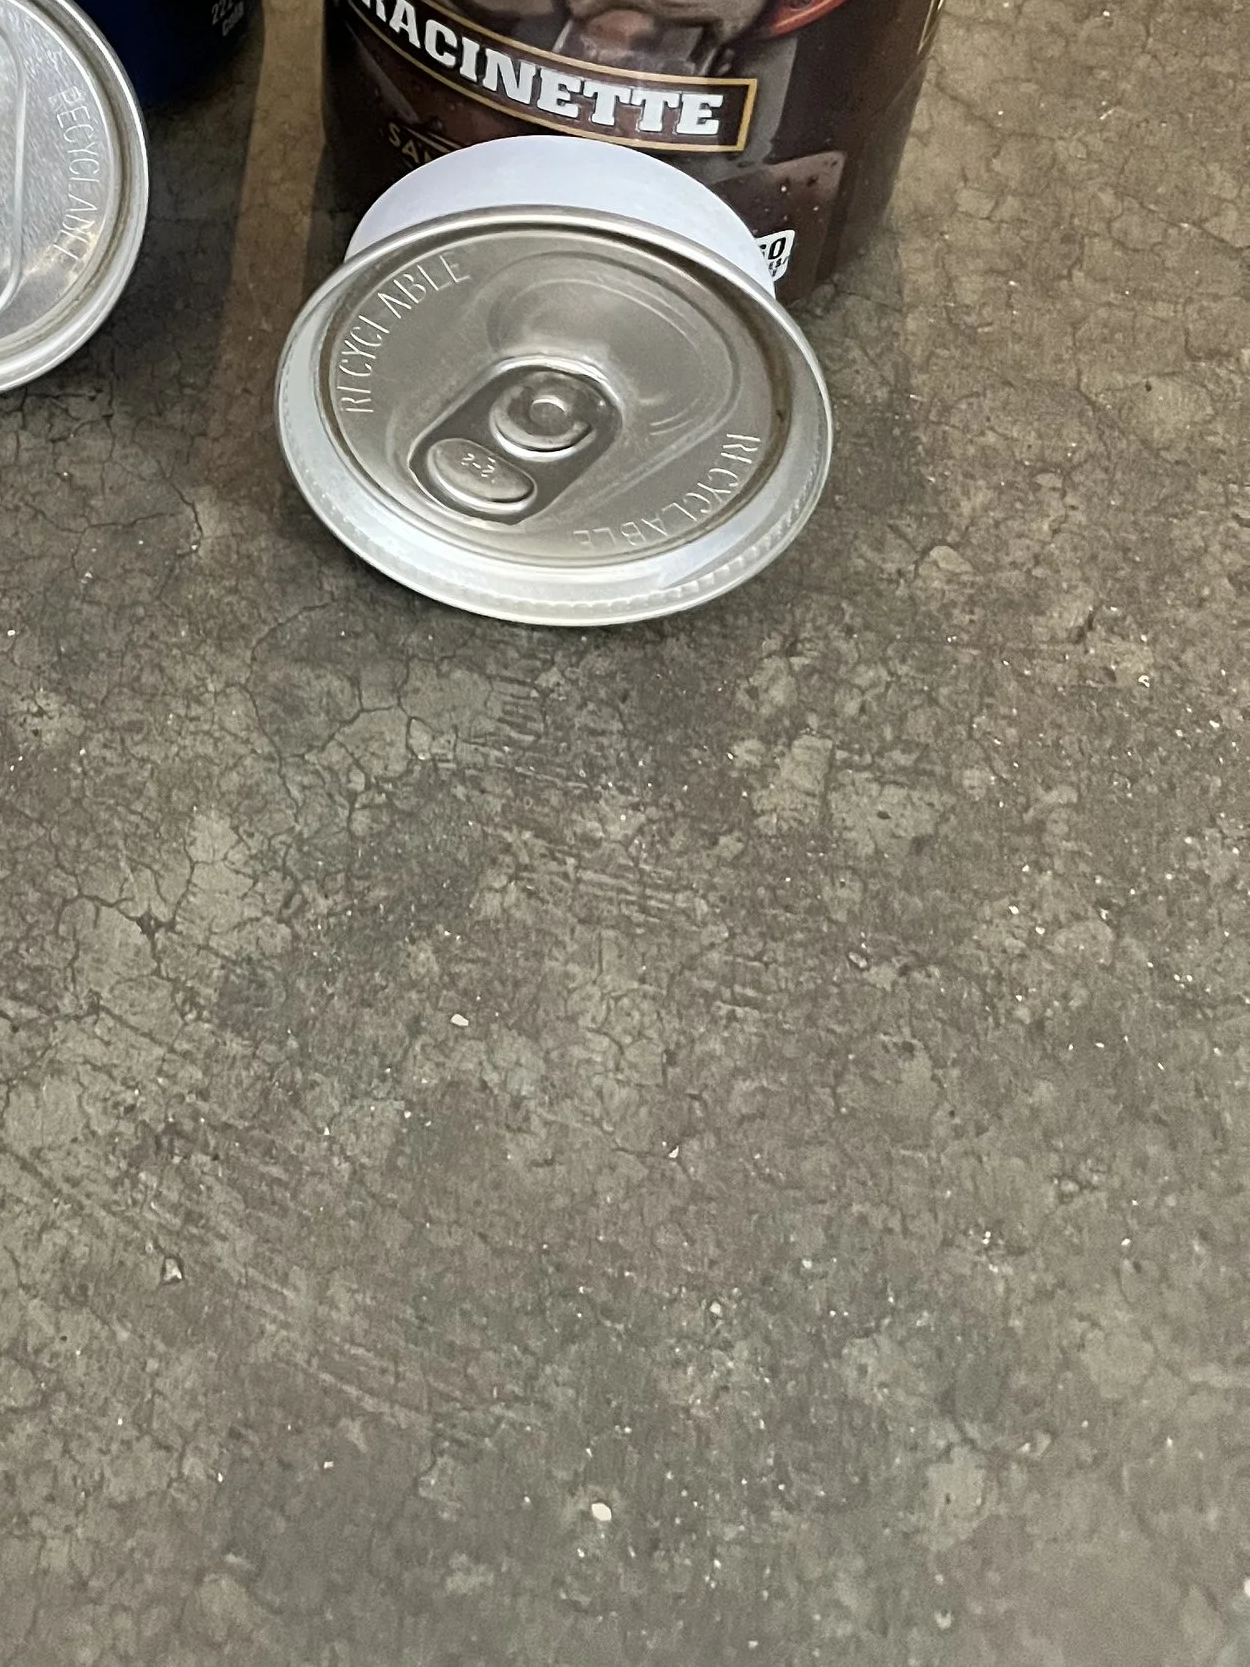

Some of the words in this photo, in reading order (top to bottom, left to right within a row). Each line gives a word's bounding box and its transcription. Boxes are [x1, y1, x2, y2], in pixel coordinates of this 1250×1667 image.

[48, 85, 100, 264] RECYCLABLE
[336, 251, 471, 414] RECYCLABLE
[572, 432, 762, 551] RECYCLABLE
